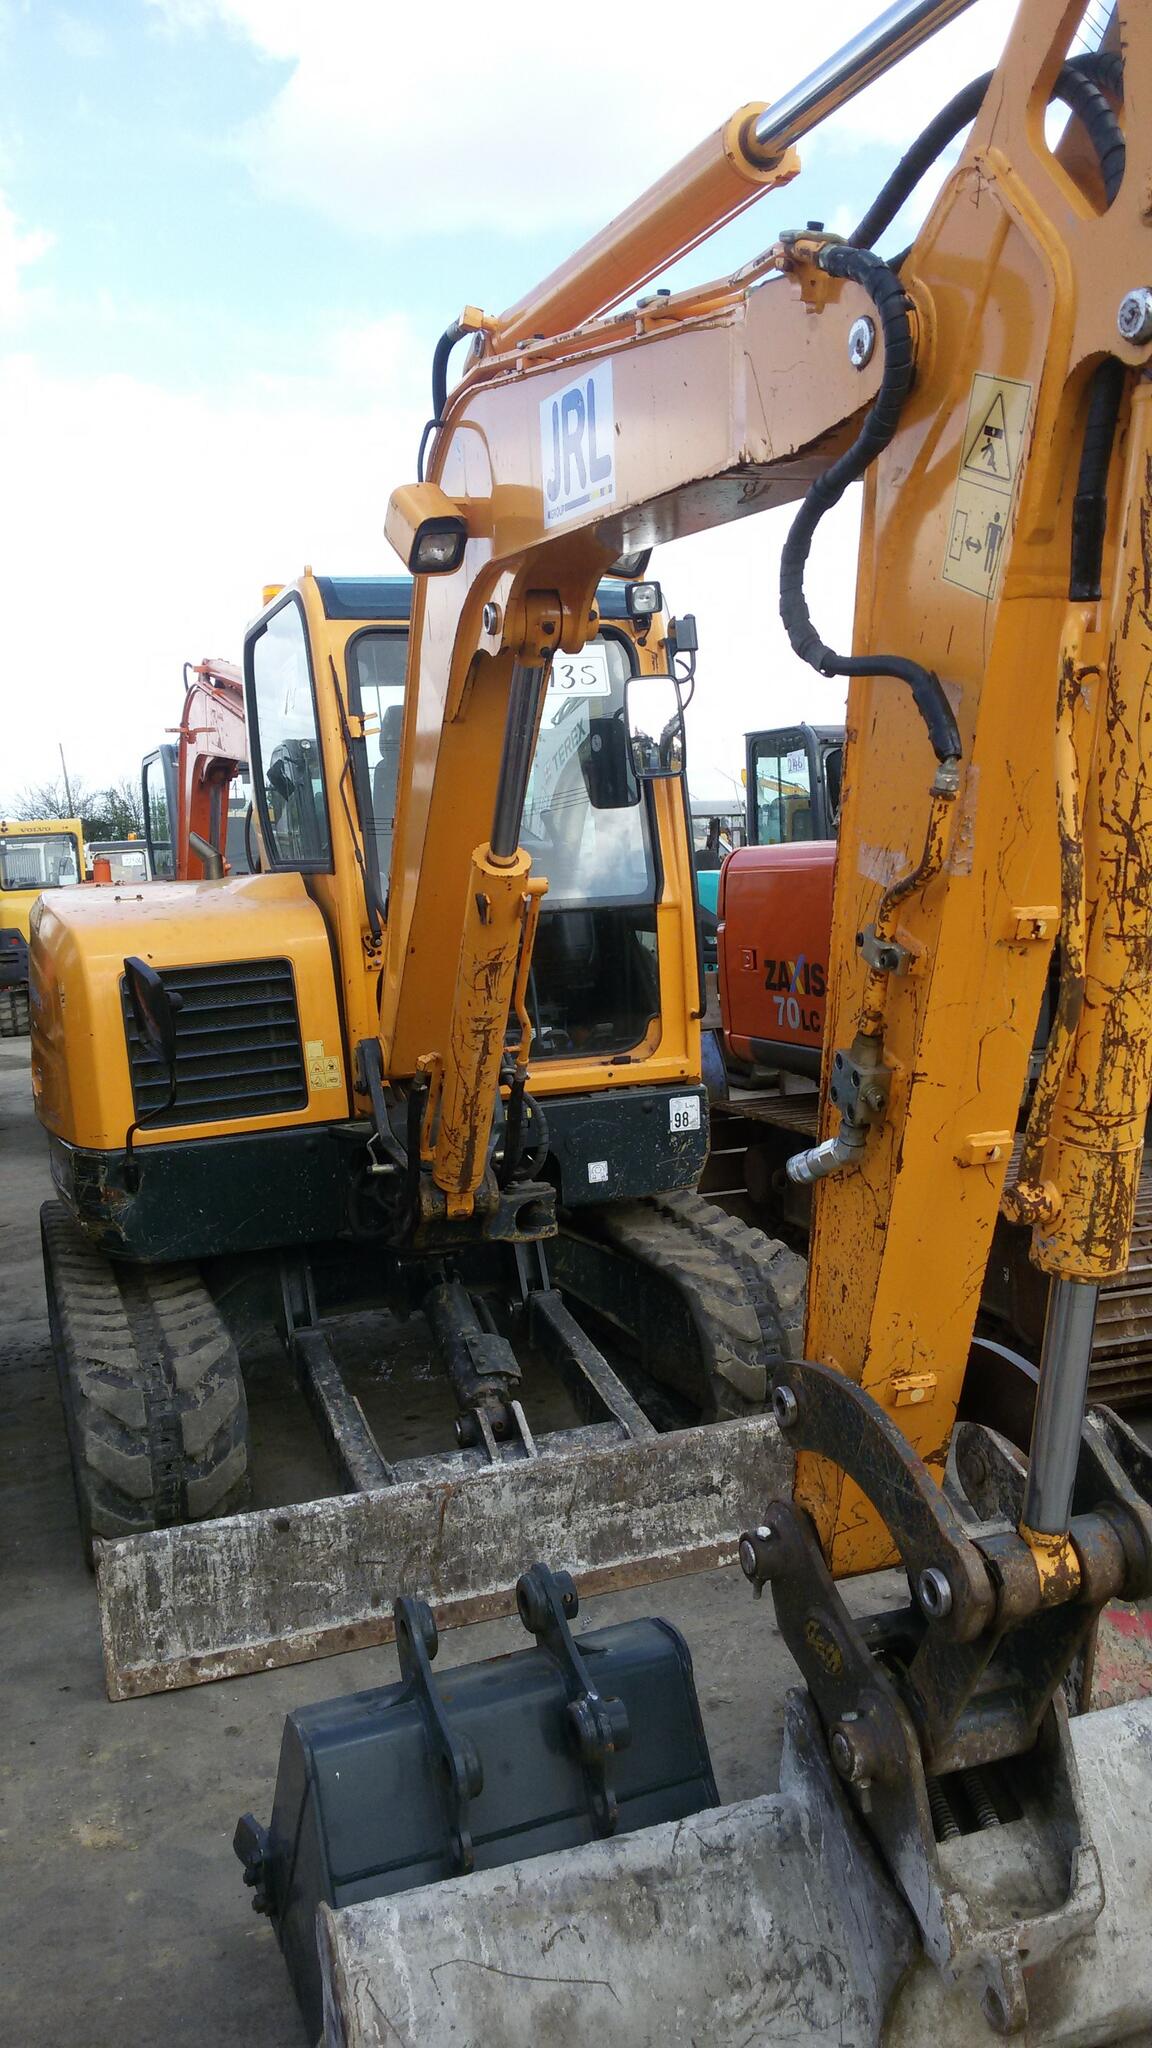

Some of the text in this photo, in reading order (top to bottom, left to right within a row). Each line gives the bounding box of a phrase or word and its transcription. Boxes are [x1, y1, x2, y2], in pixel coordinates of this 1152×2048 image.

[547, 378, 612, 502] JRL
[552, 718, 587, 771] TEREX
[764, 953, 826, 997] ZAXIS
[674, 1111, 689, 1128] 98
